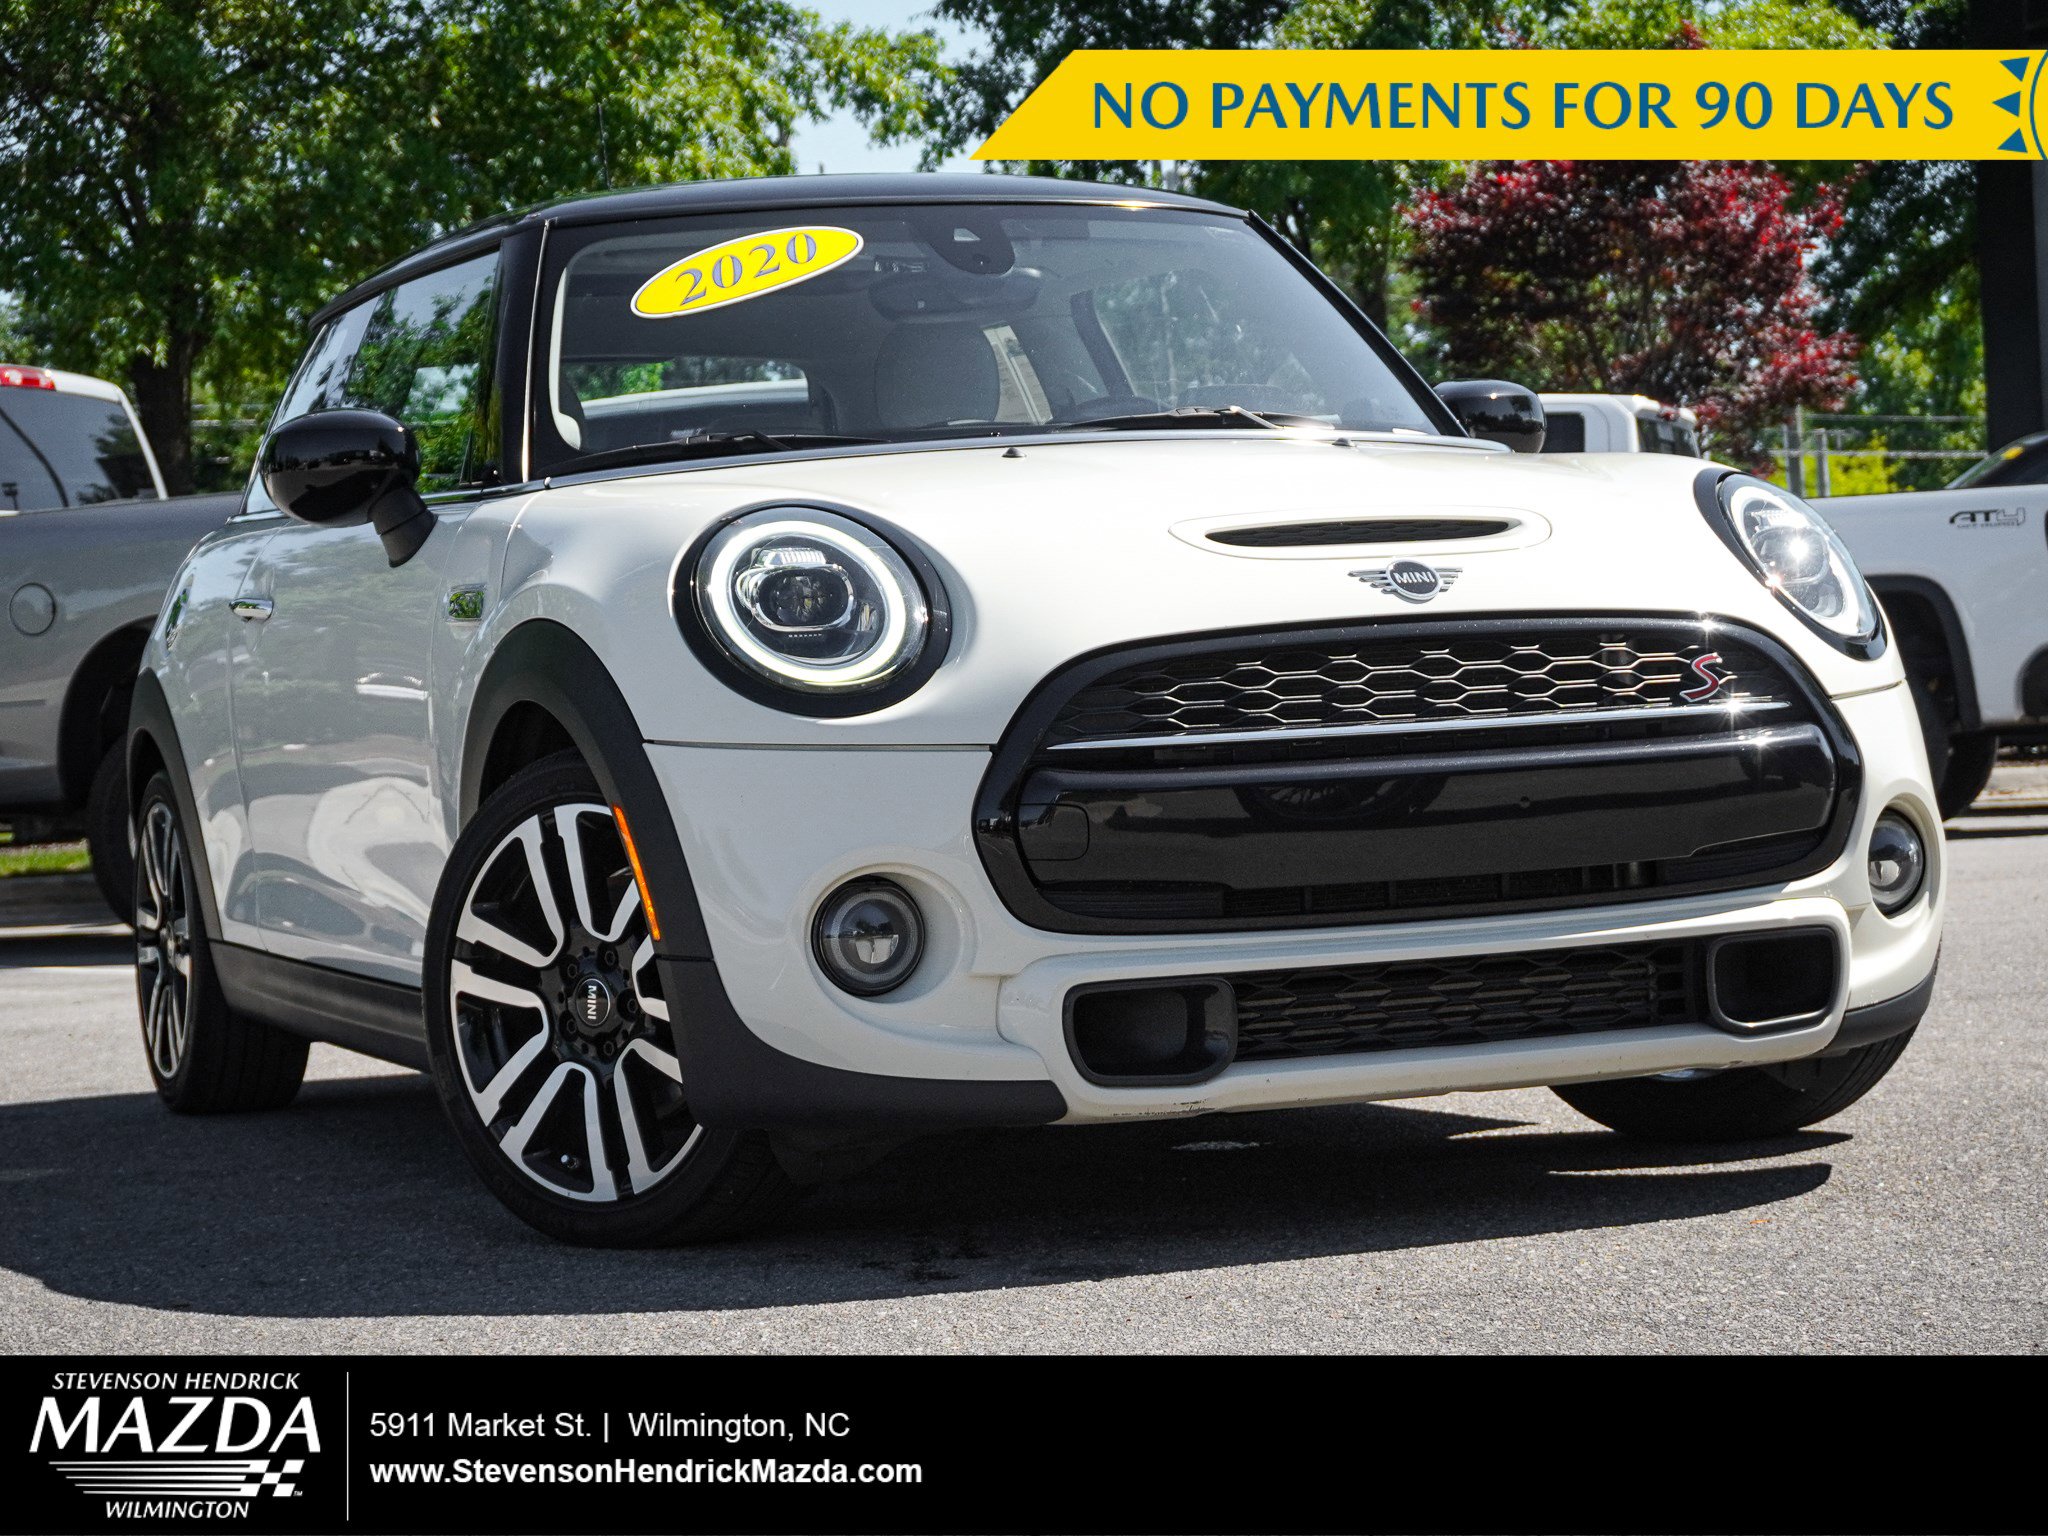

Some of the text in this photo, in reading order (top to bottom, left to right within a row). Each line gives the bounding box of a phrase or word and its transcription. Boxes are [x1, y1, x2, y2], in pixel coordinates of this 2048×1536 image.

[675, 232, 817, 307] 2020
[1949, 507, 2026, 527] AT4
[1392, 571, 1436, 584] MINI
[1679, 652, 1723, 703] S
[587, 985, 597, 1020] MINI
